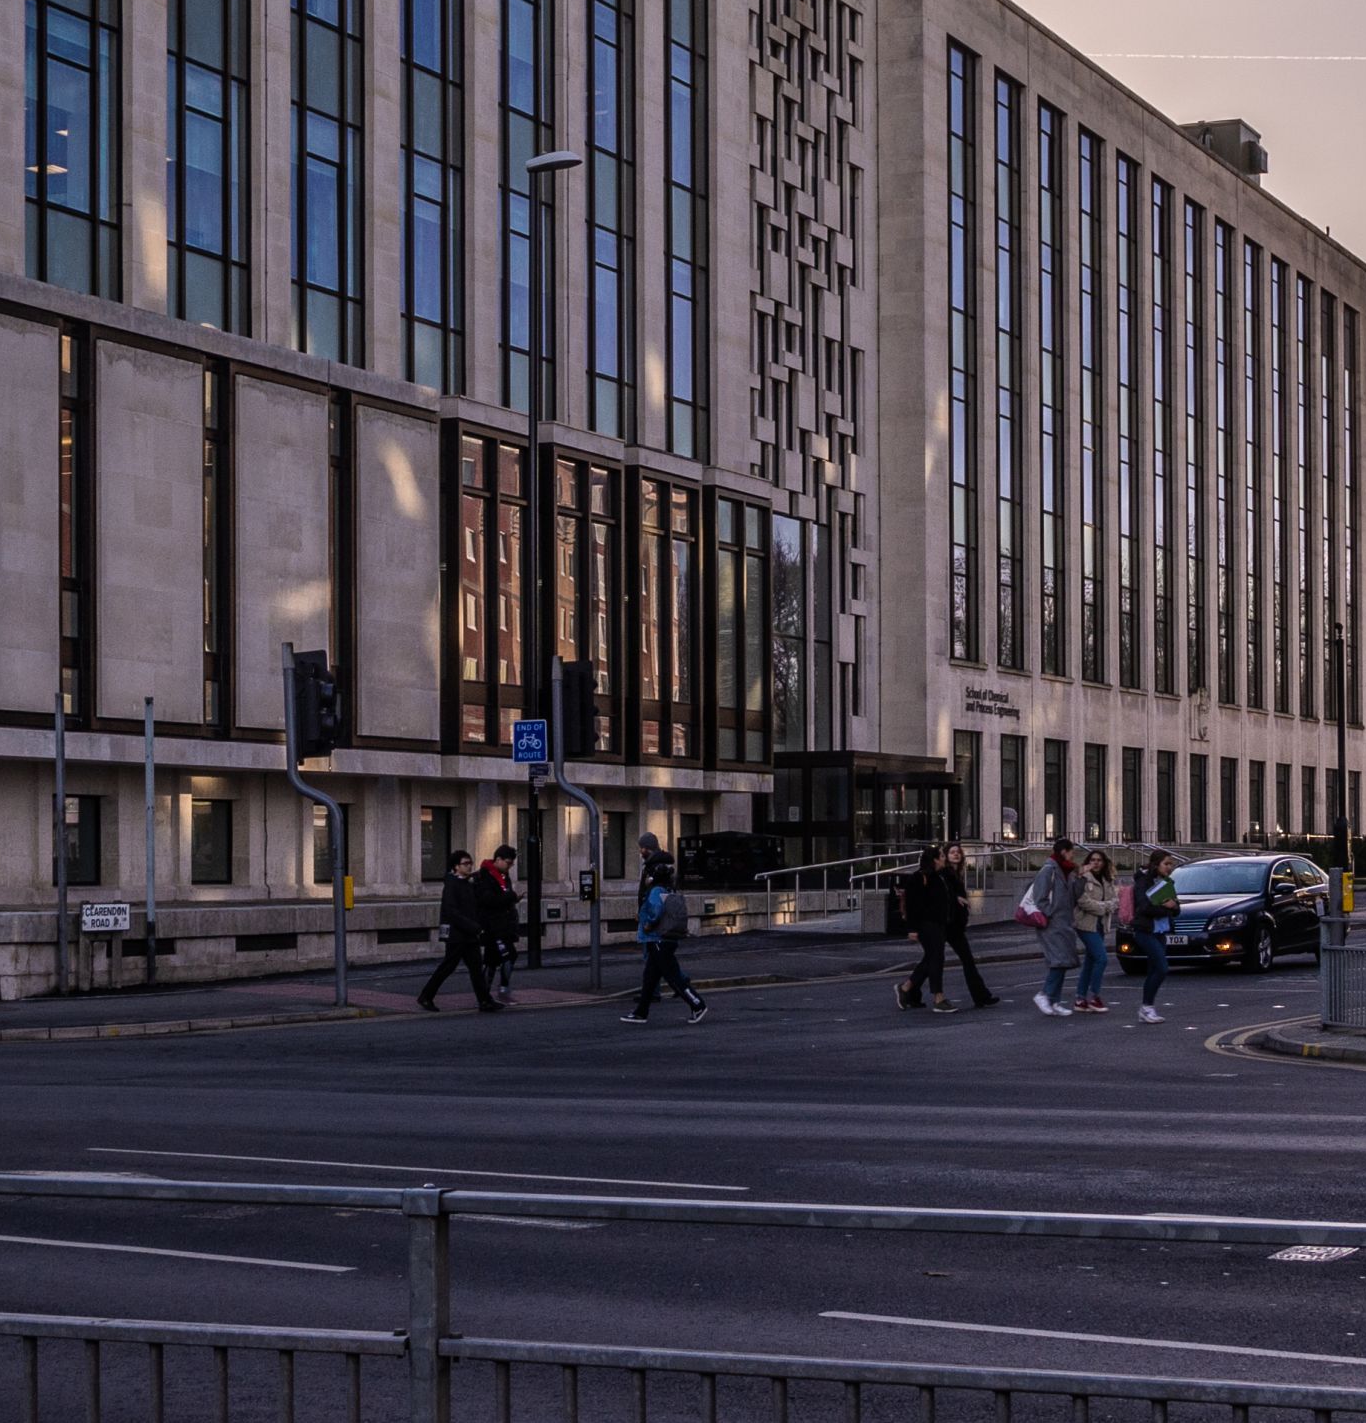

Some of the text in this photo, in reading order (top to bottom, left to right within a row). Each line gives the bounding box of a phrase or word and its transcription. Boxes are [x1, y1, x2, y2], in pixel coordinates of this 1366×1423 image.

[965, 686, 981, 699] School
[988, 690, 1009, 703] Chemical
[965, 701, 975, 712] and
[976, 701, 993, 714] Process
[516, 723, 544, 732] END OF
[518, 751, 542, 759] ROUTE
[85, 906, 127, 917] CLARENDON
[91, 918, 110, 928] ROAD
